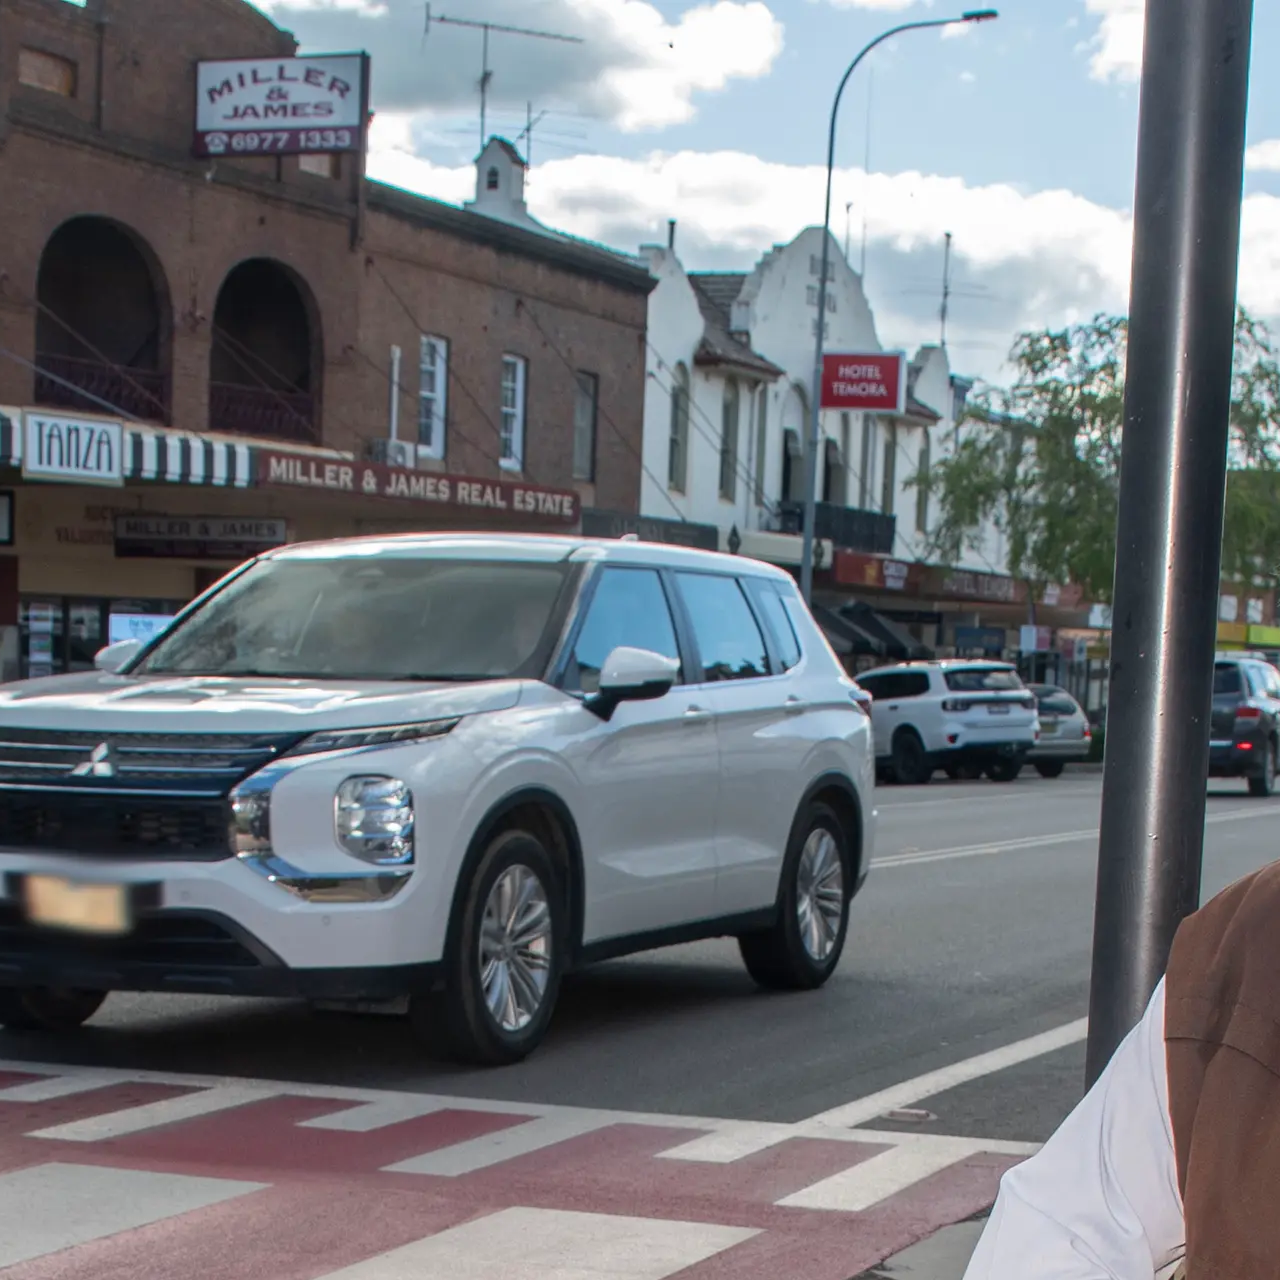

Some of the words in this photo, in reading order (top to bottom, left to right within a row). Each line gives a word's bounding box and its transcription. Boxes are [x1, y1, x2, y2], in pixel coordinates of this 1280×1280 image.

[206, 64, 351, 104] MILLER
[266, 85, 290, 102] &
[222, 102, 334, 120] JAMES
[231, 131, 290, 150] 6977
[299, 129, 351, 149] 1333
[837, 364, 882, 379] HOTEL
[831, 381, 888, 398] TEMORA
[35, 421, 112, 472] TANZA
[269, 455, 354, 490] MILLER
[361, 469, 377, 493] &
[385, 473, 450, 501] JAMES
[457, 483, 507, 509] REAL
[513, 490, 574, 517] ESTATE
[125, 519, 191, 536] MILLER
[198, 521, 210, 536] &
[220, 522, 278, 538] JAMES
